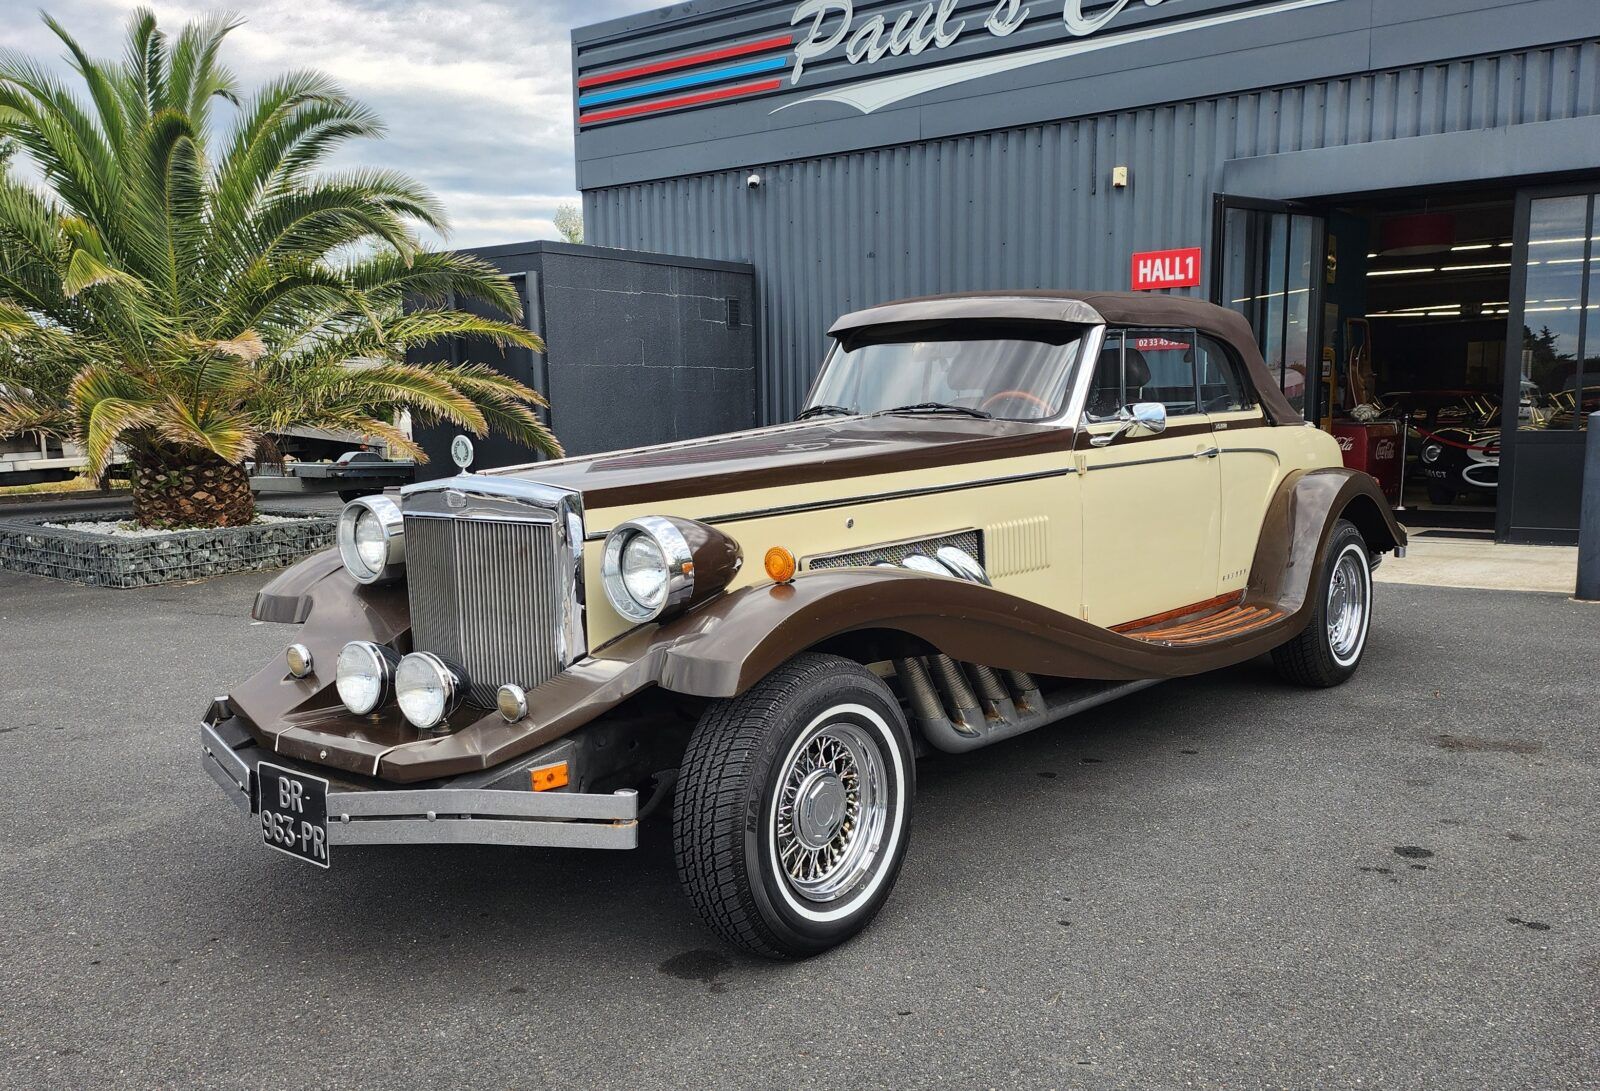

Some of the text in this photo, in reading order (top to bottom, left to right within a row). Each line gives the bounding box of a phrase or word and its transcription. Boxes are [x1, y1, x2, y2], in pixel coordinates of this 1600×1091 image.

[791, 0, 1031, 85] Pauls
[1138, 338, 1148, 347] 02
[1149, 338, 1158, 346] 33
[261, 809, 326, 860] 963-PR
